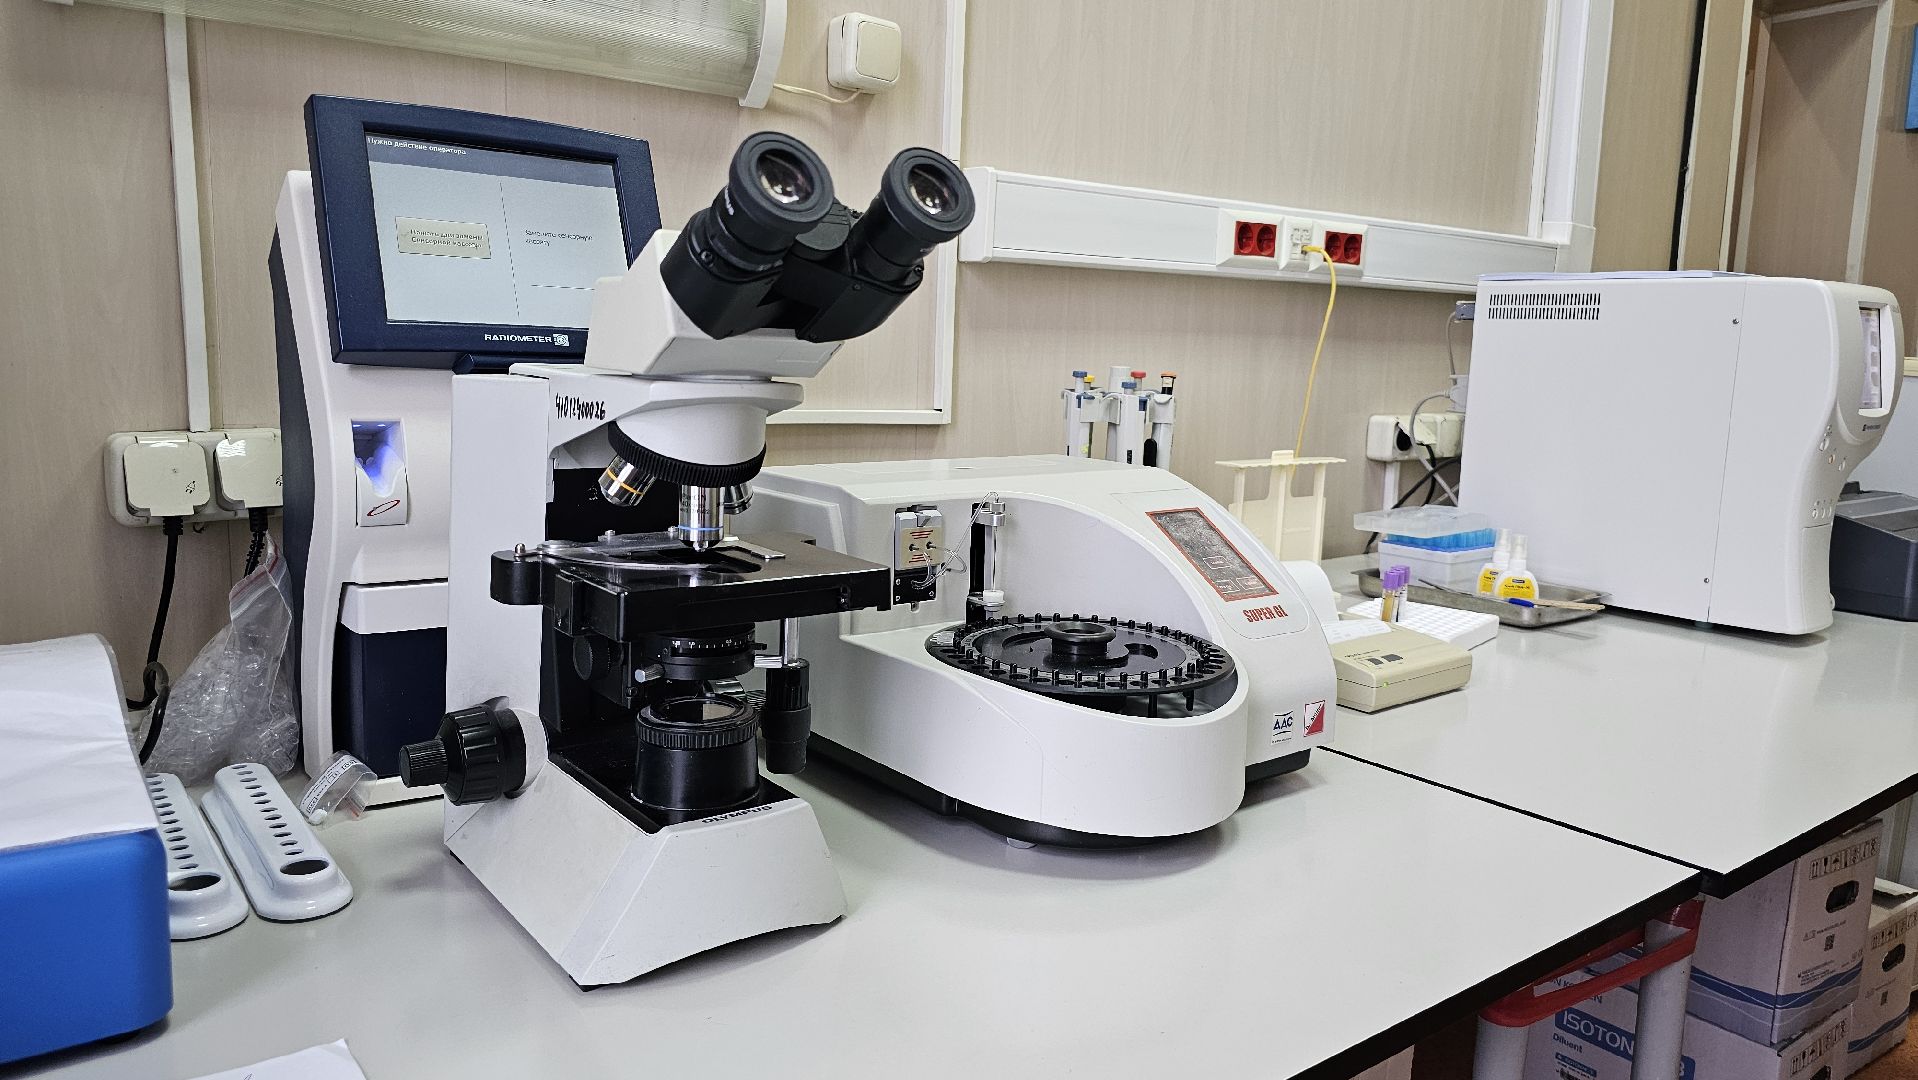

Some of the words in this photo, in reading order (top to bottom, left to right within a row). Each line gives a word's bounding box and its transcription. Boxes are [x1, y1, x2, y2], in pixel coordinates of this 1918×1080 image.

[367, 137, 392, 146] Нужно
[394, 141, 428, 151] действие
[429, 145, 467, 155] оператора
[484, 333, 552, 343] RADIOMETER
[1242, 606, 1276, 623] SUPER
[1272, 716, 1294, 731] AAC
[701, 805, 773, 824] OLYMPUS
[1552, 1032, 1583, 1054] Diluent
